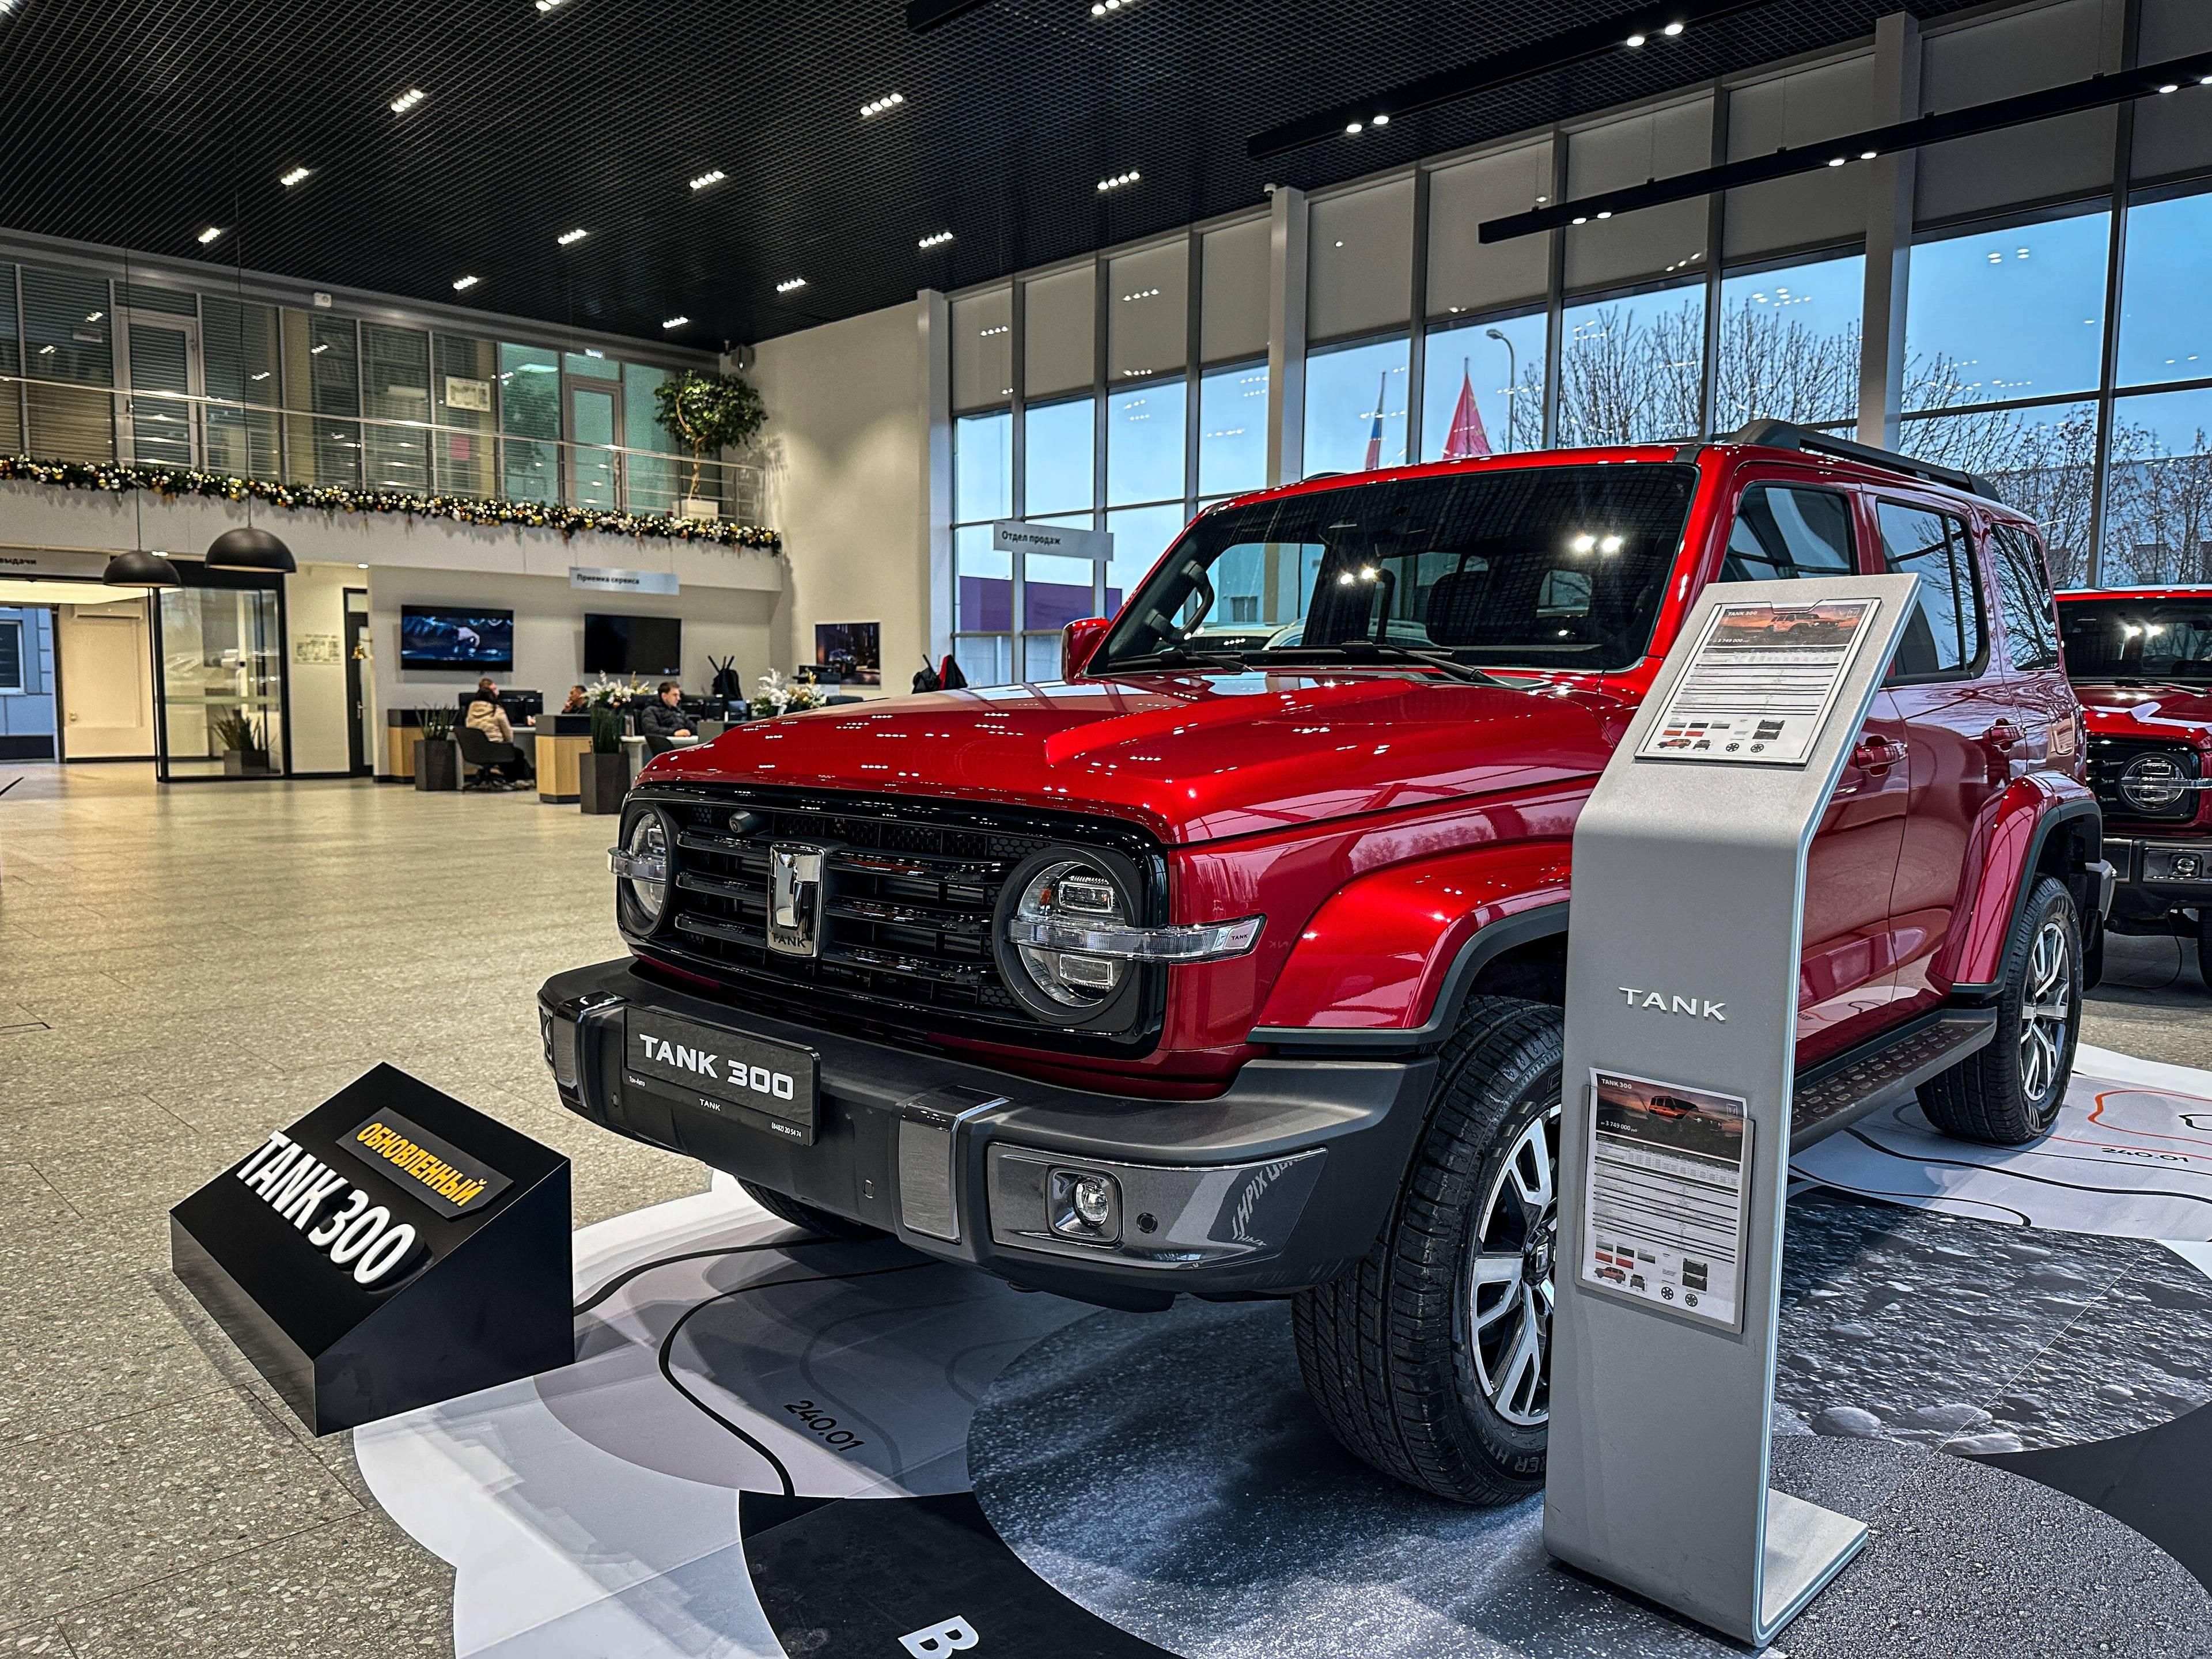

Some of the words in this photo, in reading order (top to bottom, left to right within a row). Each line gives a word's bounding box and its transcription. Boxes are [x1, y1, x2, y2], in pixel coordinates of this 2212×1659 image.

[1001, 531, 1028, 542] Отдел
[1029, 536, 1061, 546] продаж
[611, 577, 639, 585] сервиса
[771, 931, 806, 948] TANK
[1618, 986, 1726, 1021] TANK
[639, 1033, 719, 1079] TANK
[727, 1059, 794, 1101] 300
[1601, 1078, 1619, 1087] TANK
[699, 1098, 721, 1111] TANK
[2101, 1147, 2189, 1162] 240.01
[356, 1122, 488, 1207] ОБНОВЛЕННЫЙ
[236, 1130, 349, 1230] TANK
[307, 1188, 417, 1285] 300
[783, 1400, 865, 1452] 240.01
